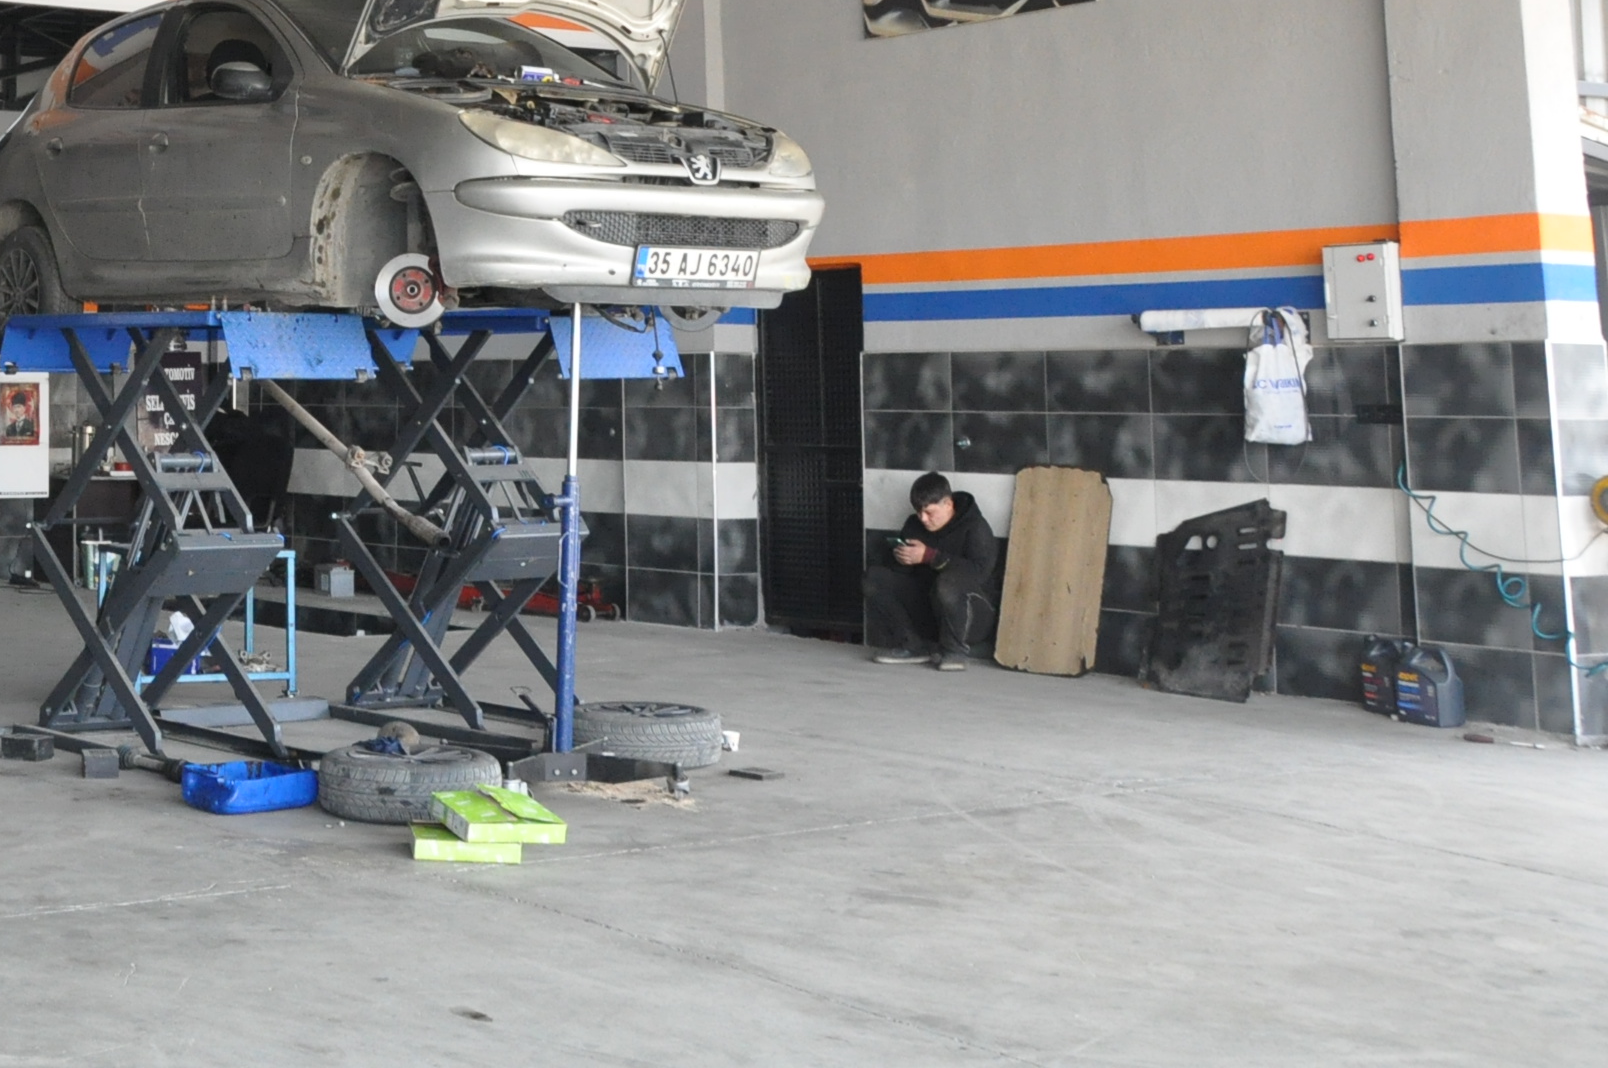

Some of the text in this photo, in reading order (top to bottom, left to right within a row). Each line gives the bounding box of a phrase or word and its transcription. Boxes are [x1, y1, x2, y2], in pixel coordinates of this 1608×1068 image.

[648, 251, 754, 277] 35 AJ 6340
